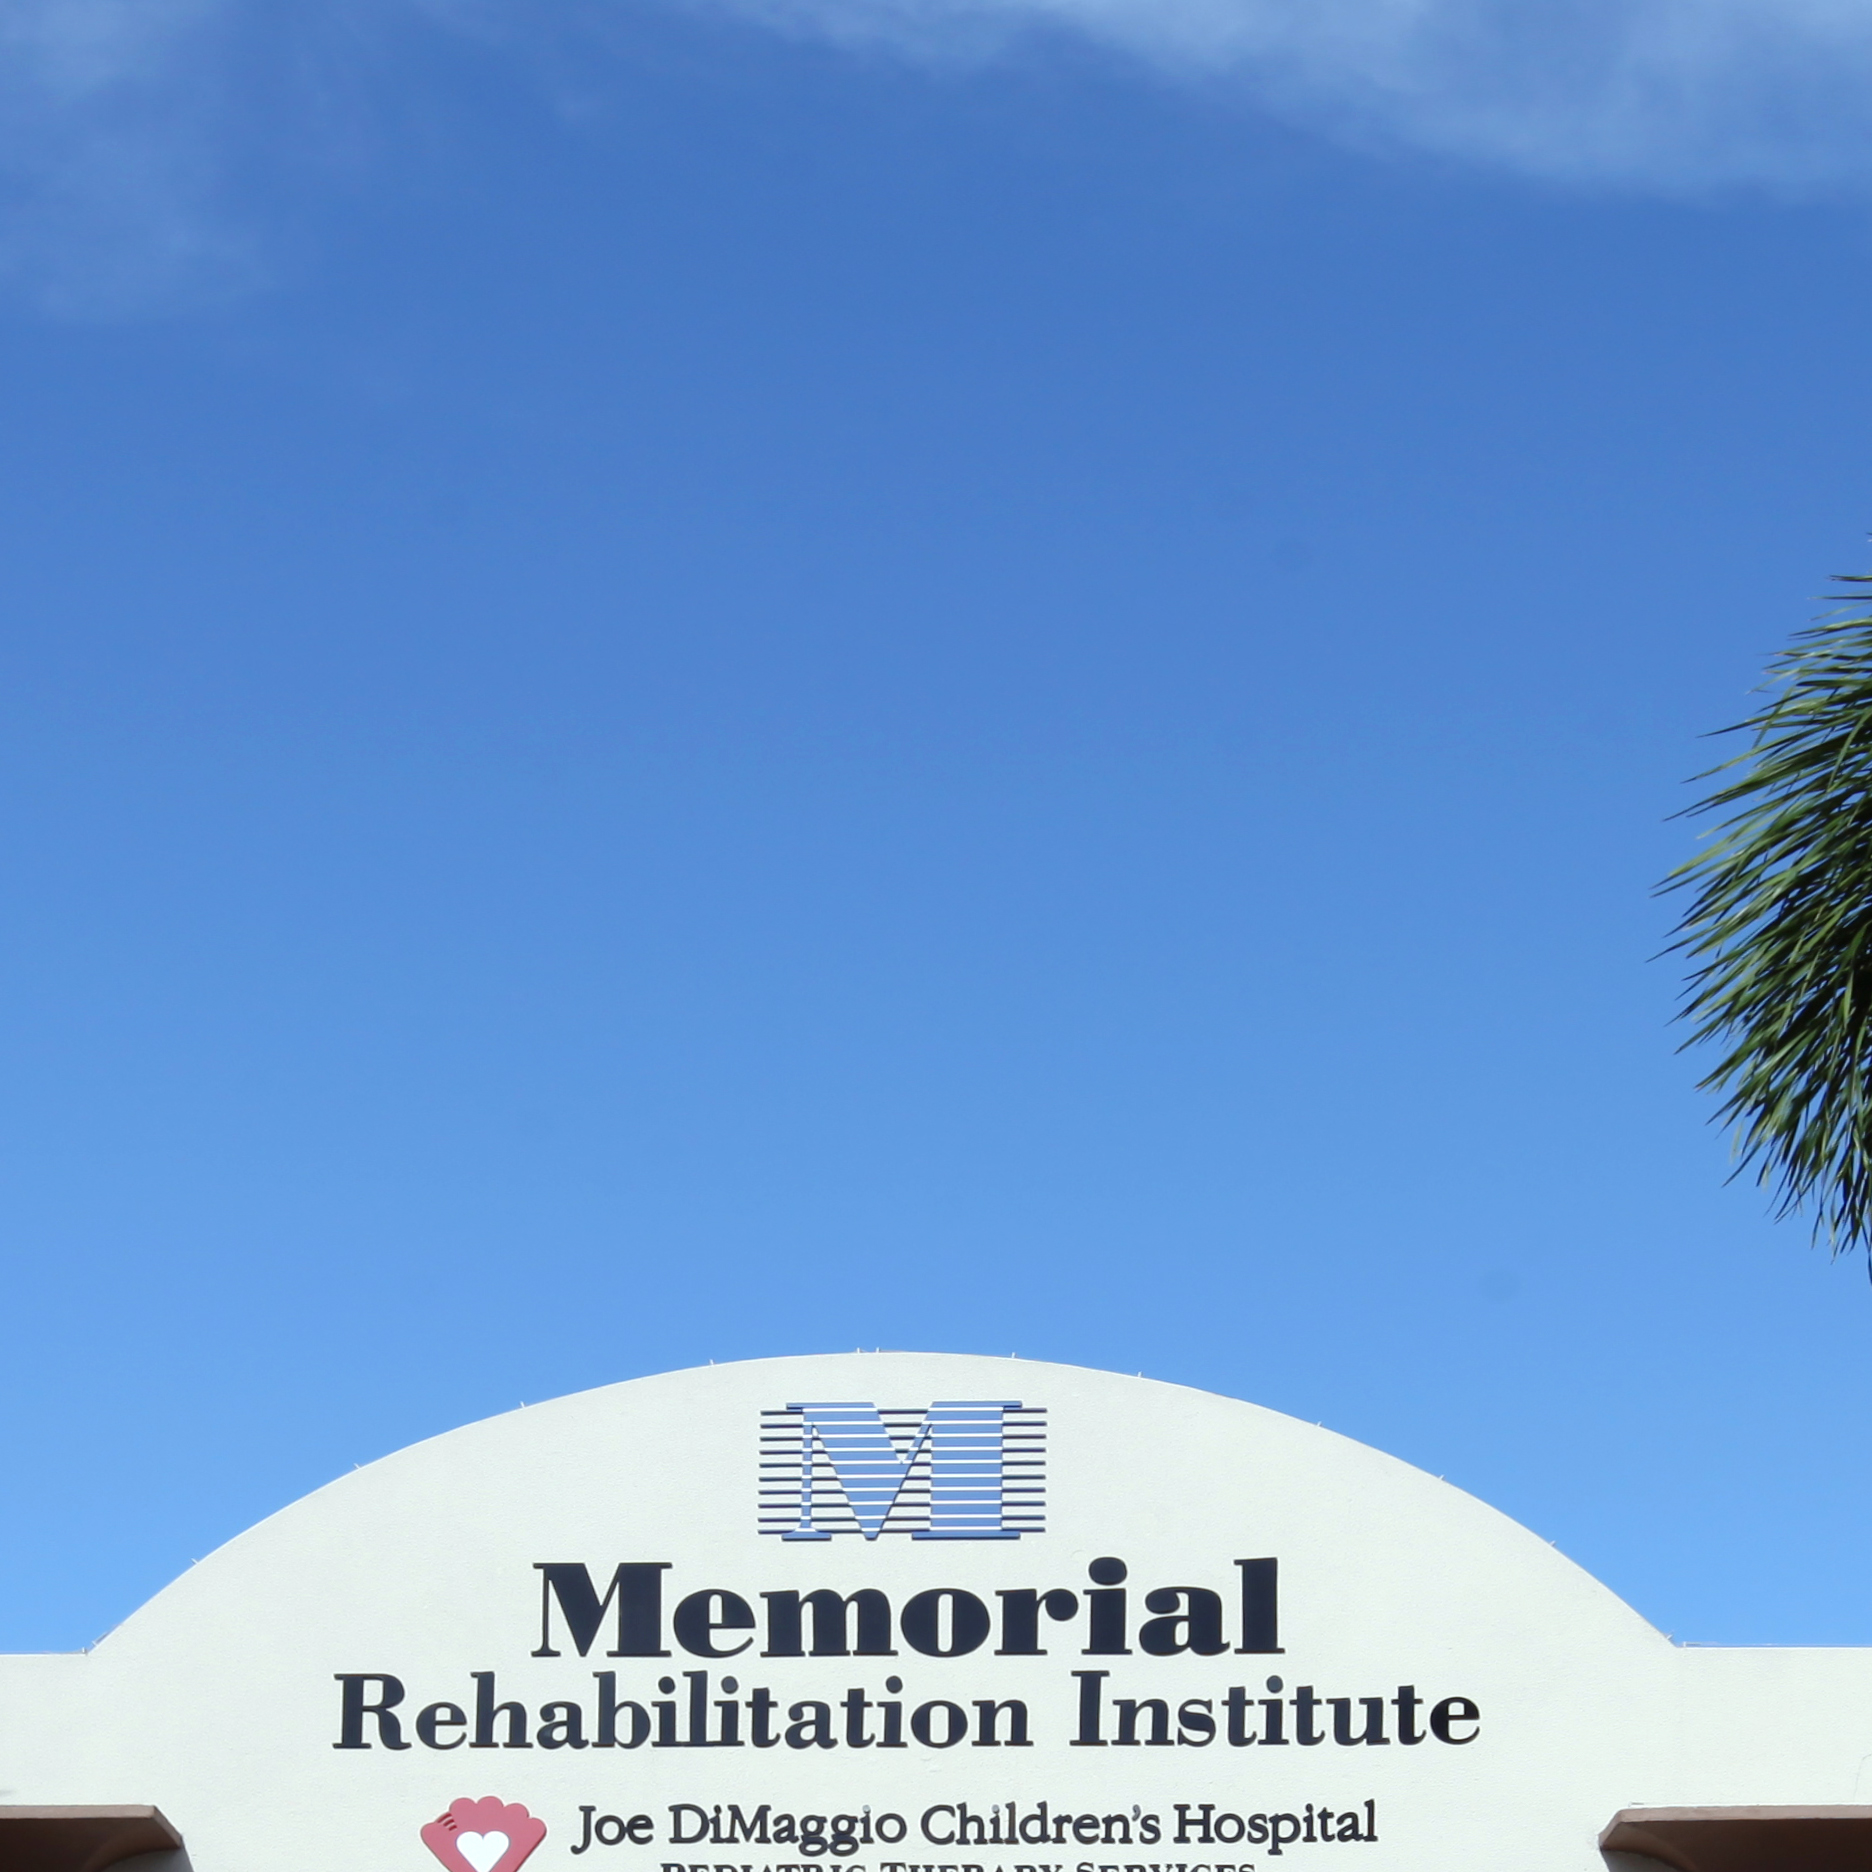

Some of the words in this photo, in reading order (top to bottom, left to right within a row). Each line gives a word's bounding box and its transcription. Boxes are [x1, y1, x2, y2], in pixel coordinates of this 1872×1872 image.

[530, 1556, 1286, 1658] Memorial
[332, 1670, 1034, 1751] Rehabilitation
[1069, 1669, 1482, 1748] Institute
[570, 1804, 655, 1856] Joe
[668, 1803, 909, 1857] DiMaggio
[919, 1800, 1162, 1846] Children's
[1172, 1798, 1379, 1856] Hospital
